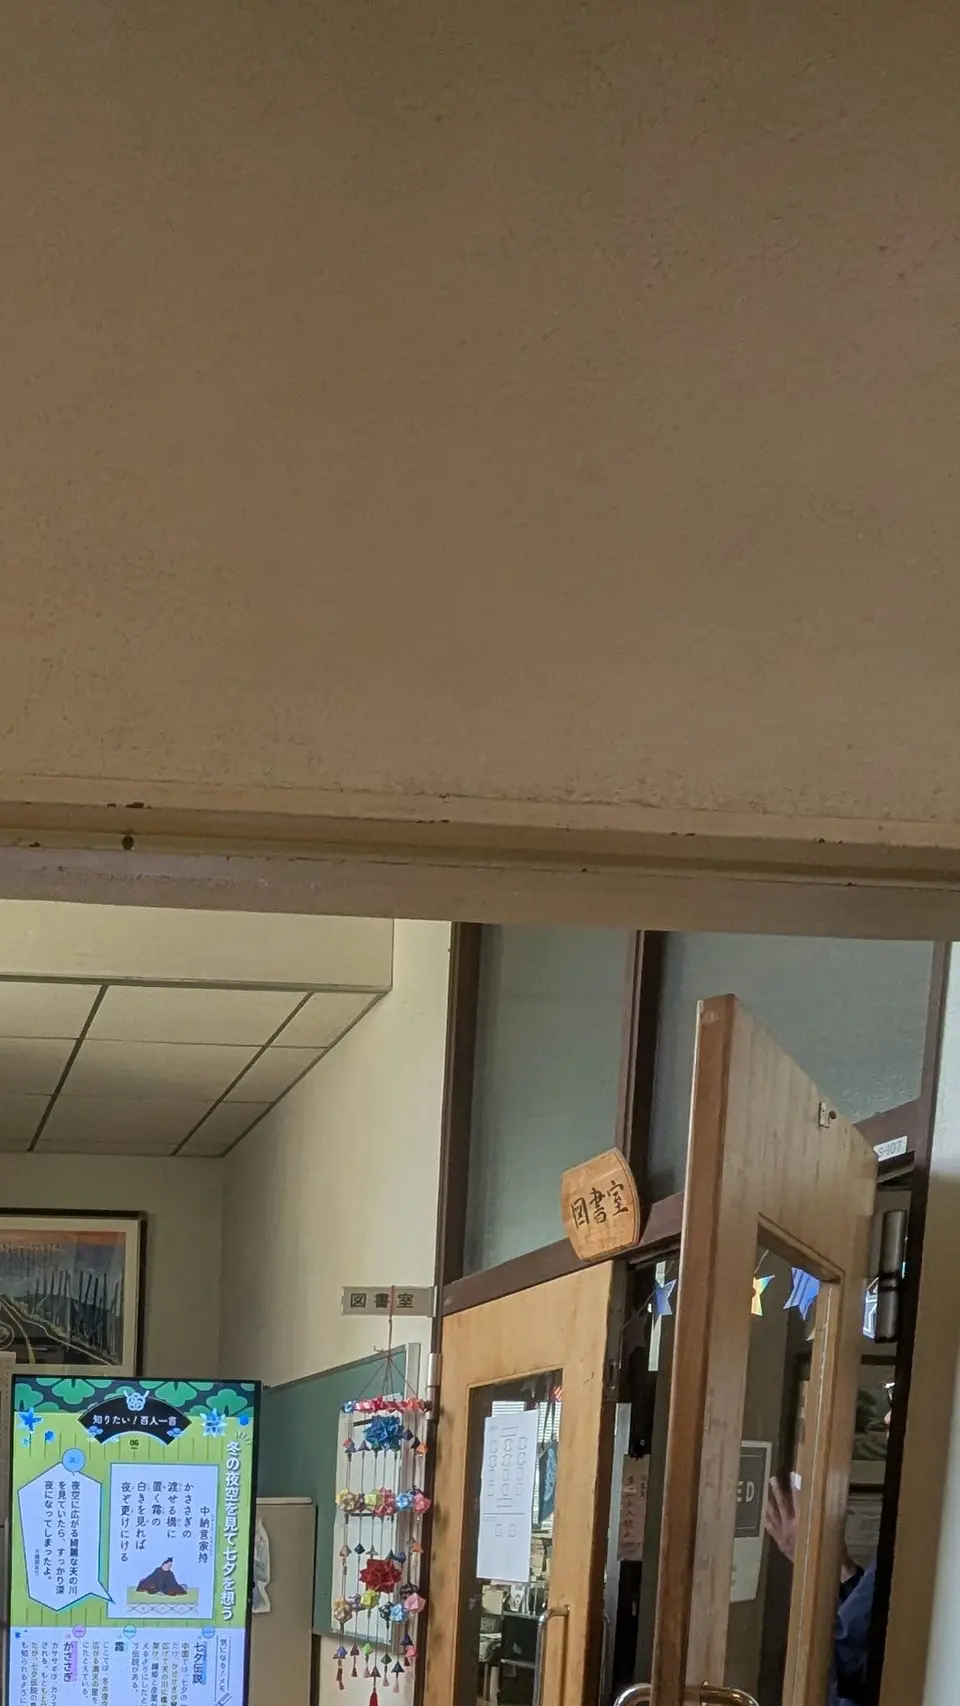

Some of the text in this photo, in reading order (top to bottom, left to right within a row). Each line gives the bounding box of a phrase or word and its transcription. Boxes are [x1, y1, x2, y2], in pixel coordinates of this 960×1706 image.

[570, 1179, 628, 1229] 図書室
[350, 1292, 414, 1308] 図書室
[43, 1480, 54, 1580] 夜になってしまったよ。
[120, 1481, 132, 1562] 夜ぞ更けにける
[135, 1481, 147, 1550] 白きを見れば
[151, 1481, 162, 1527] 置く霜の
[166, 1481, 179, 1539] 渡せる橋に
[182, 1482, 194, 1539] かささぎの
[222, 1441, 241, 1621] 冬の夜空を見て七夕を想う
[68, 1480, 80, 1595] 夜空に広がる綺麗な天の川
[197, 1505, 210, 1564] 中納言家持
[63, 1641, 73, 1683] かささぎ
[191, 1641, 204, 1685] 七夕伝説
